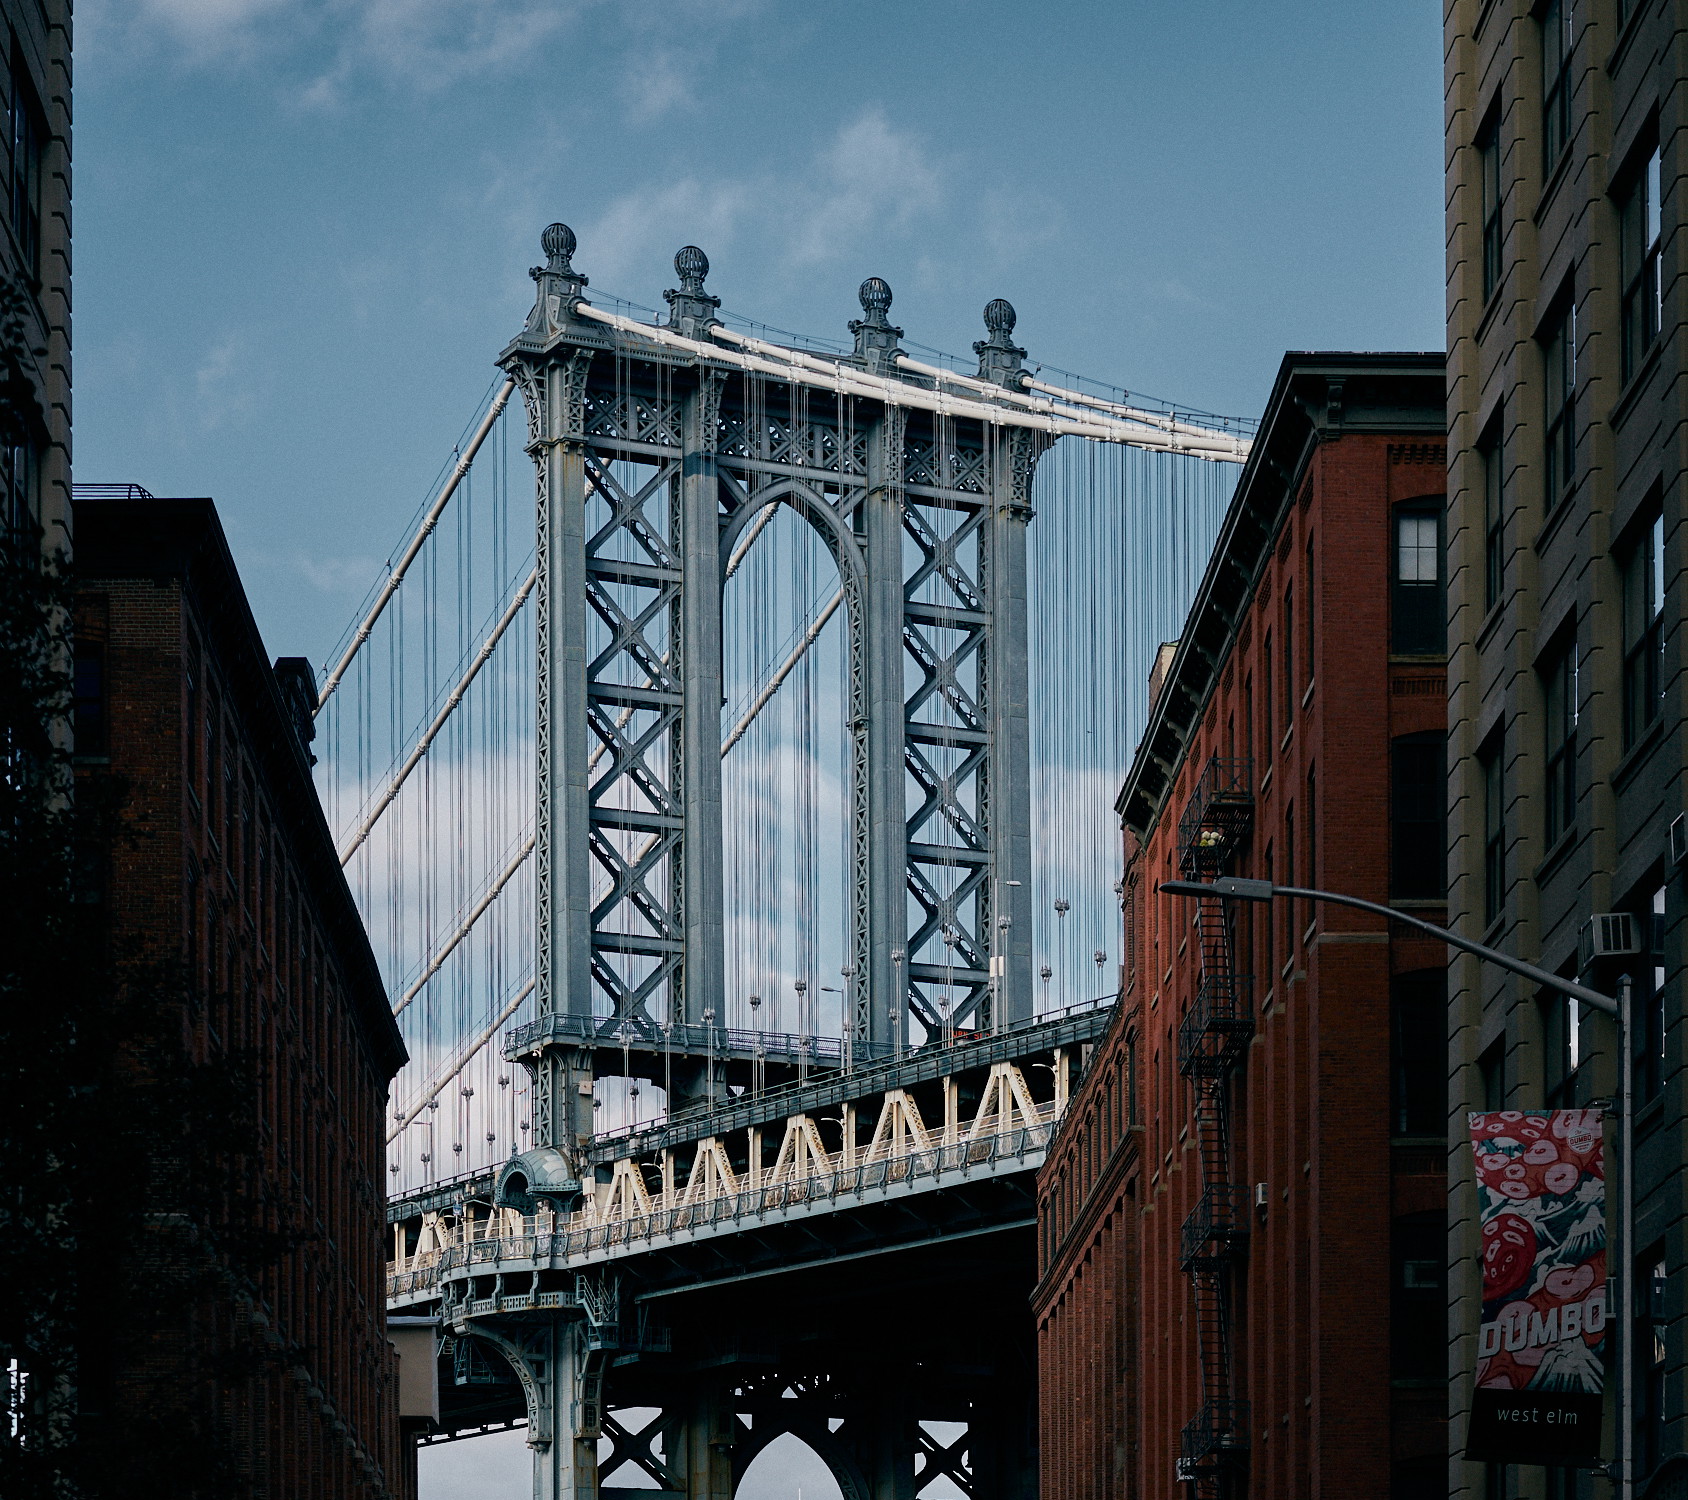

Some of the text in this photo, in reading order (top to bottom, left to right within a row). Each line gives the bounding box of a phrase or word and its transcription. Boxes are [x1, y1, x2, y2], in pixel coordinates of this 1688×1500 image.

[1570, 1134, 1592, 1145] DUMBO
[1479, 1297, 1606, 1360] DUMBO
[1497, 1407, 1578, 1425] west elm
